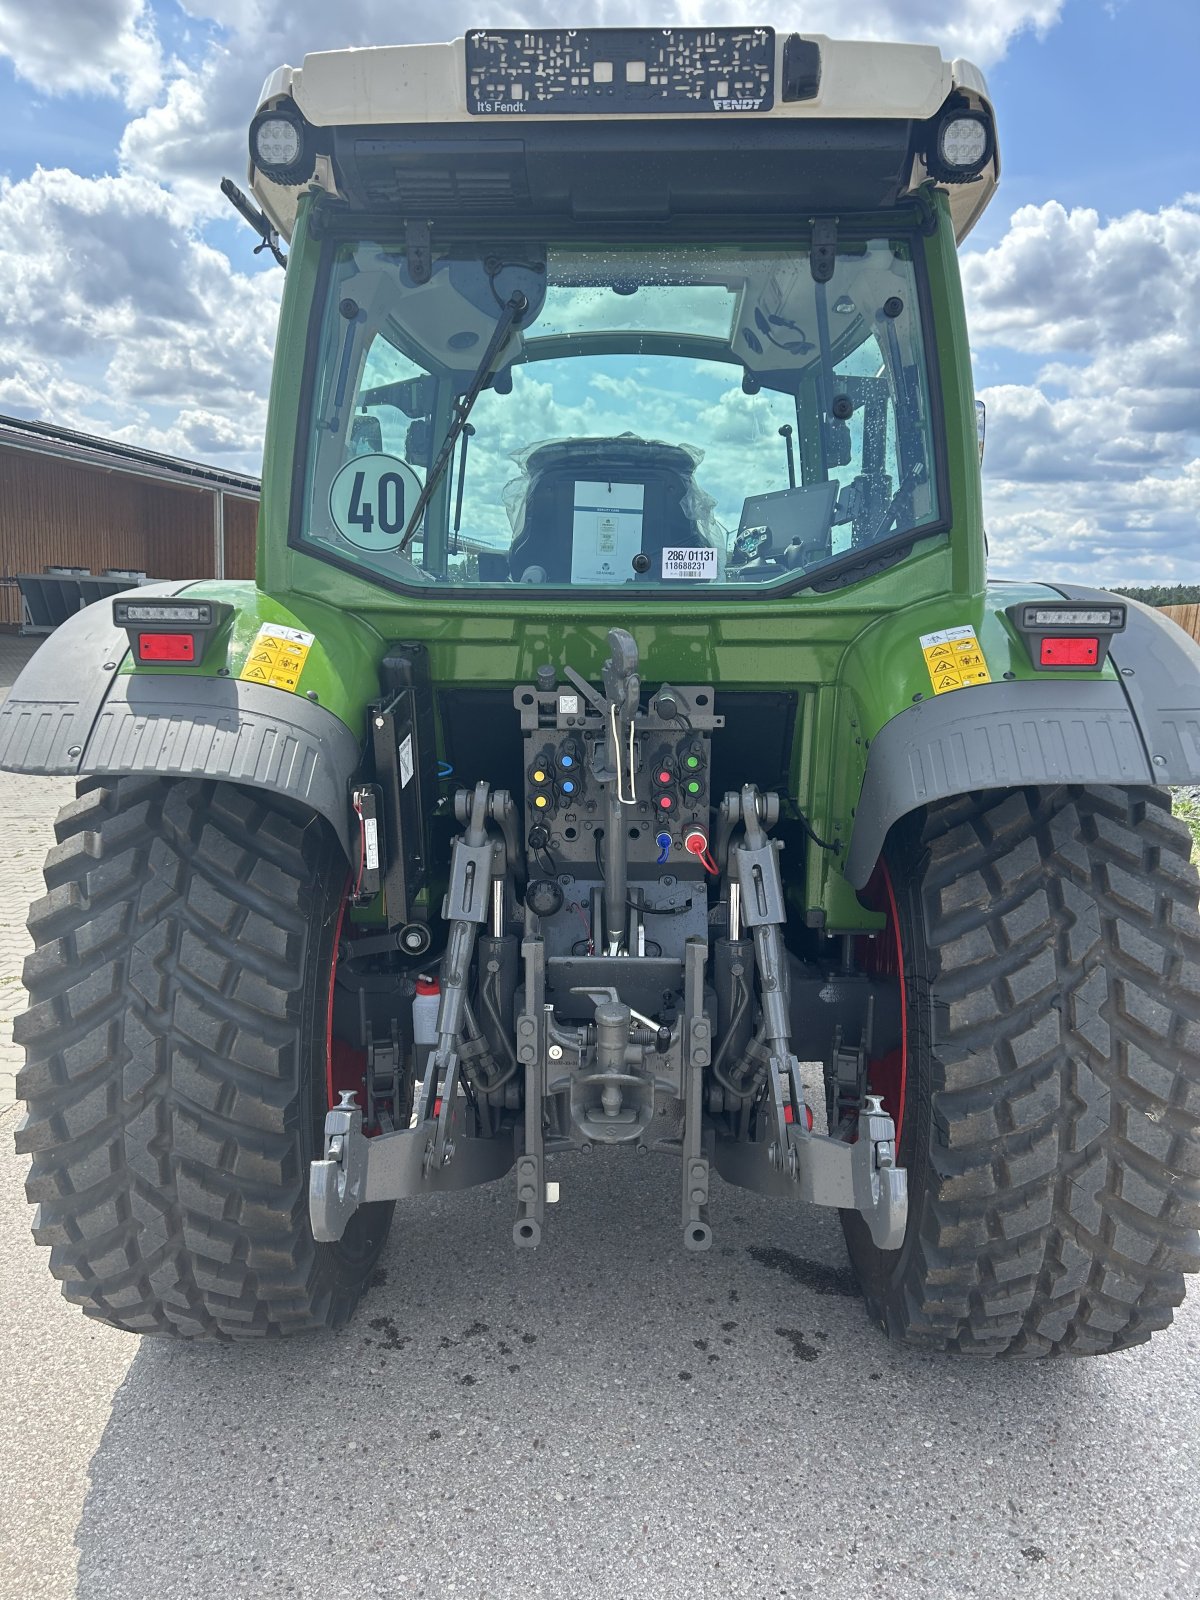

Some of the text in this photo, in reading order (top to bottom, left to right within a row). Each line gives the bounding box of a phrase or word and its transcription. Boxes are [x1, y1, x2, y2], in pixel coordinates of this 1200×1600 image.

[477, 101, 526, 112] It's Fendt.
[713, 99, 763, 110] FENDT
[347, 471, 405, 535] 40
[665, 561, 705, 570] 118688231
